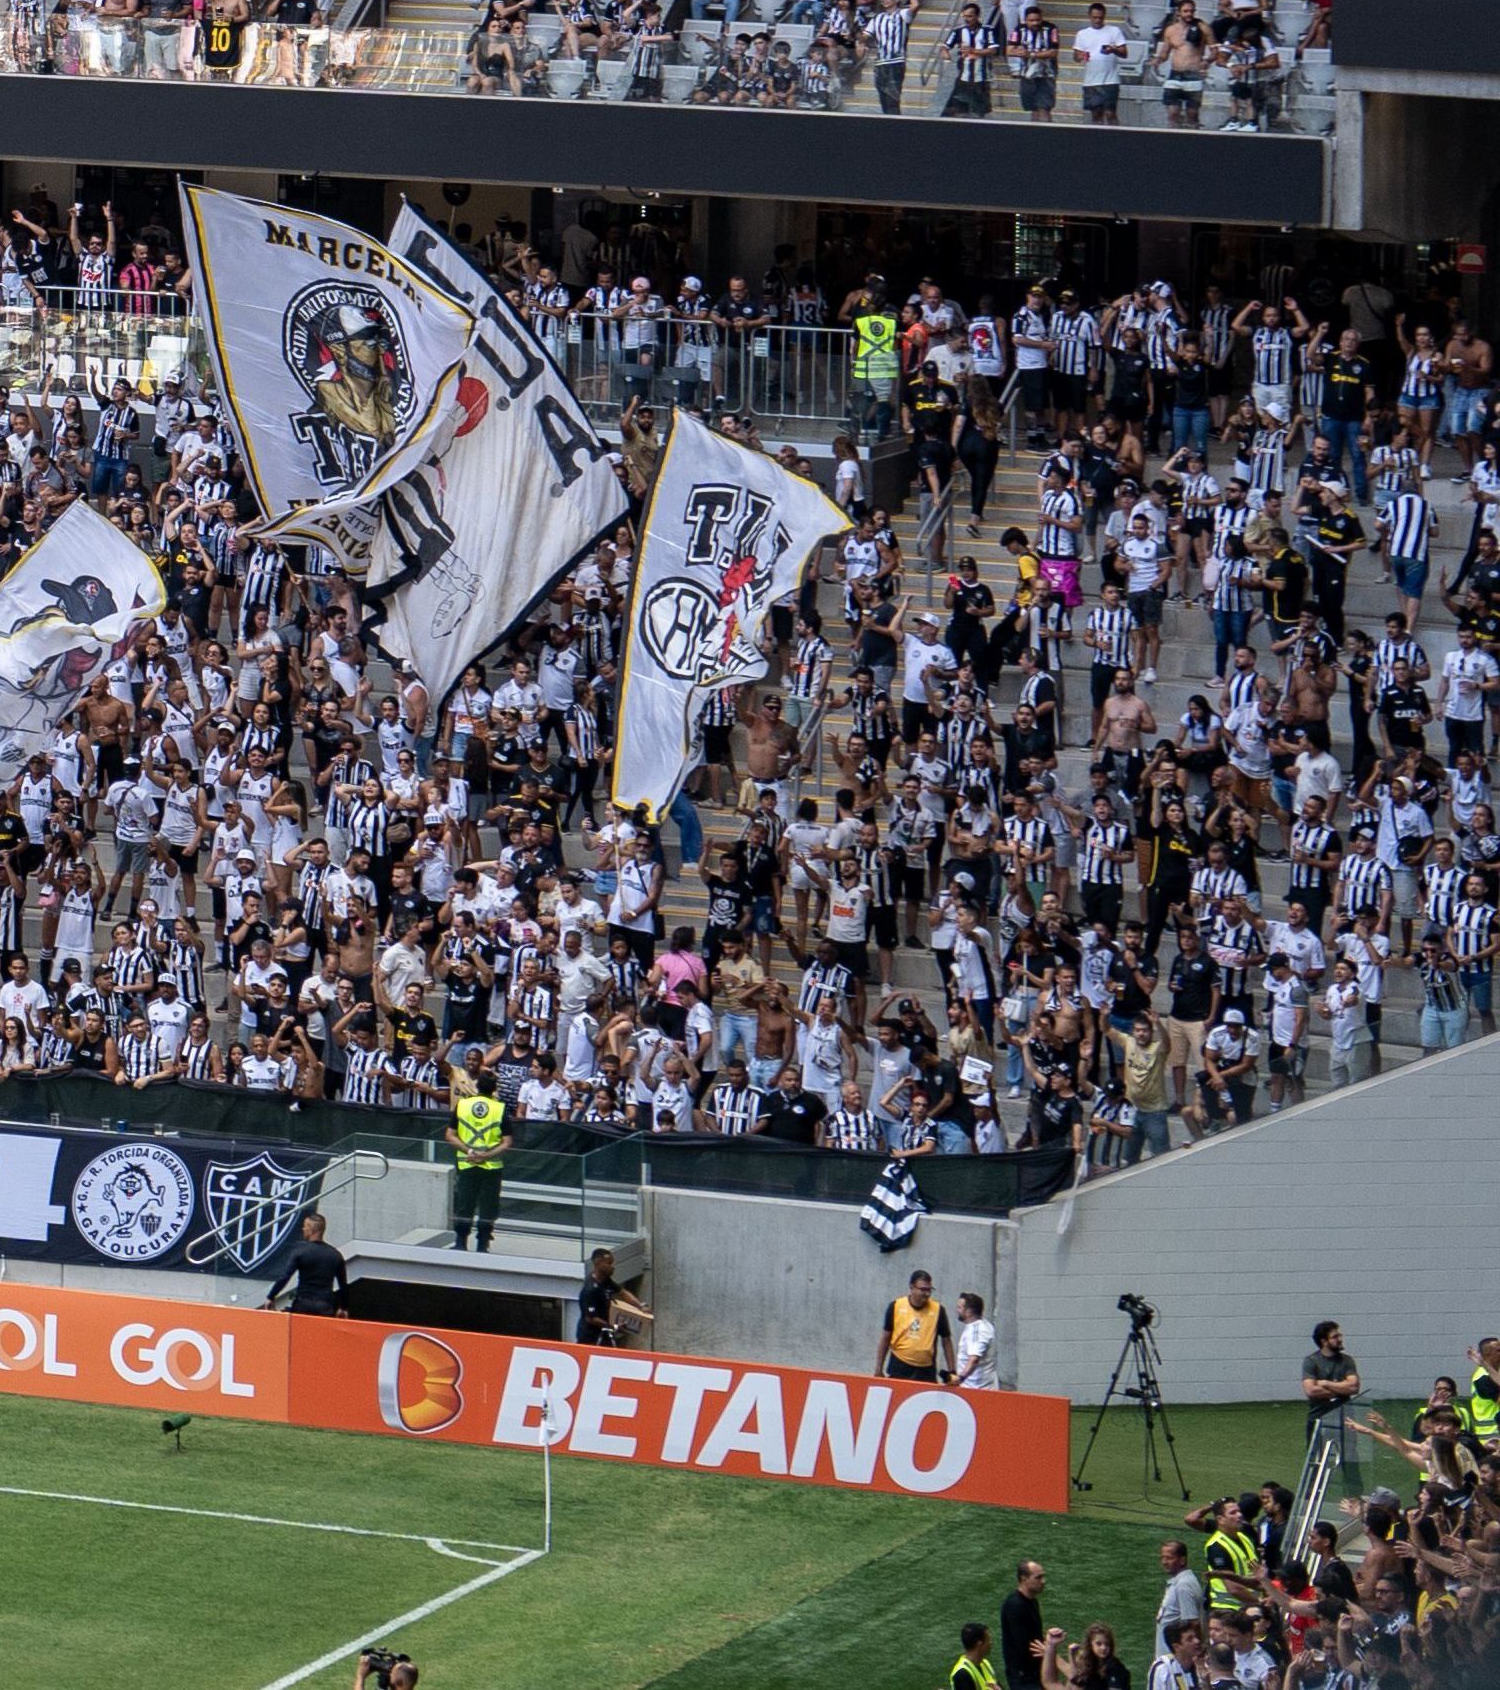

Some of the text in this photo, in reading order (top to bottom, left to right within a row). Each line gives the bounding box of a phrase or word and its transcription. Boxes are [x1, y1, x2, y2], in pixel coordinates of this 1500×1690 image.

[211, 28, 231, 52] 10
[102, 1149, 148, 1172] TORCIDA
[148, 1148, 191, 1212] ORGANIZADA
[220, 1174, 303, 1199] CAM
[80, 1220, 185, 1258] GALOUCURA
[109, 1322, 256, 1398] GOL
[493, 1344, 978, 1494] BETANO
